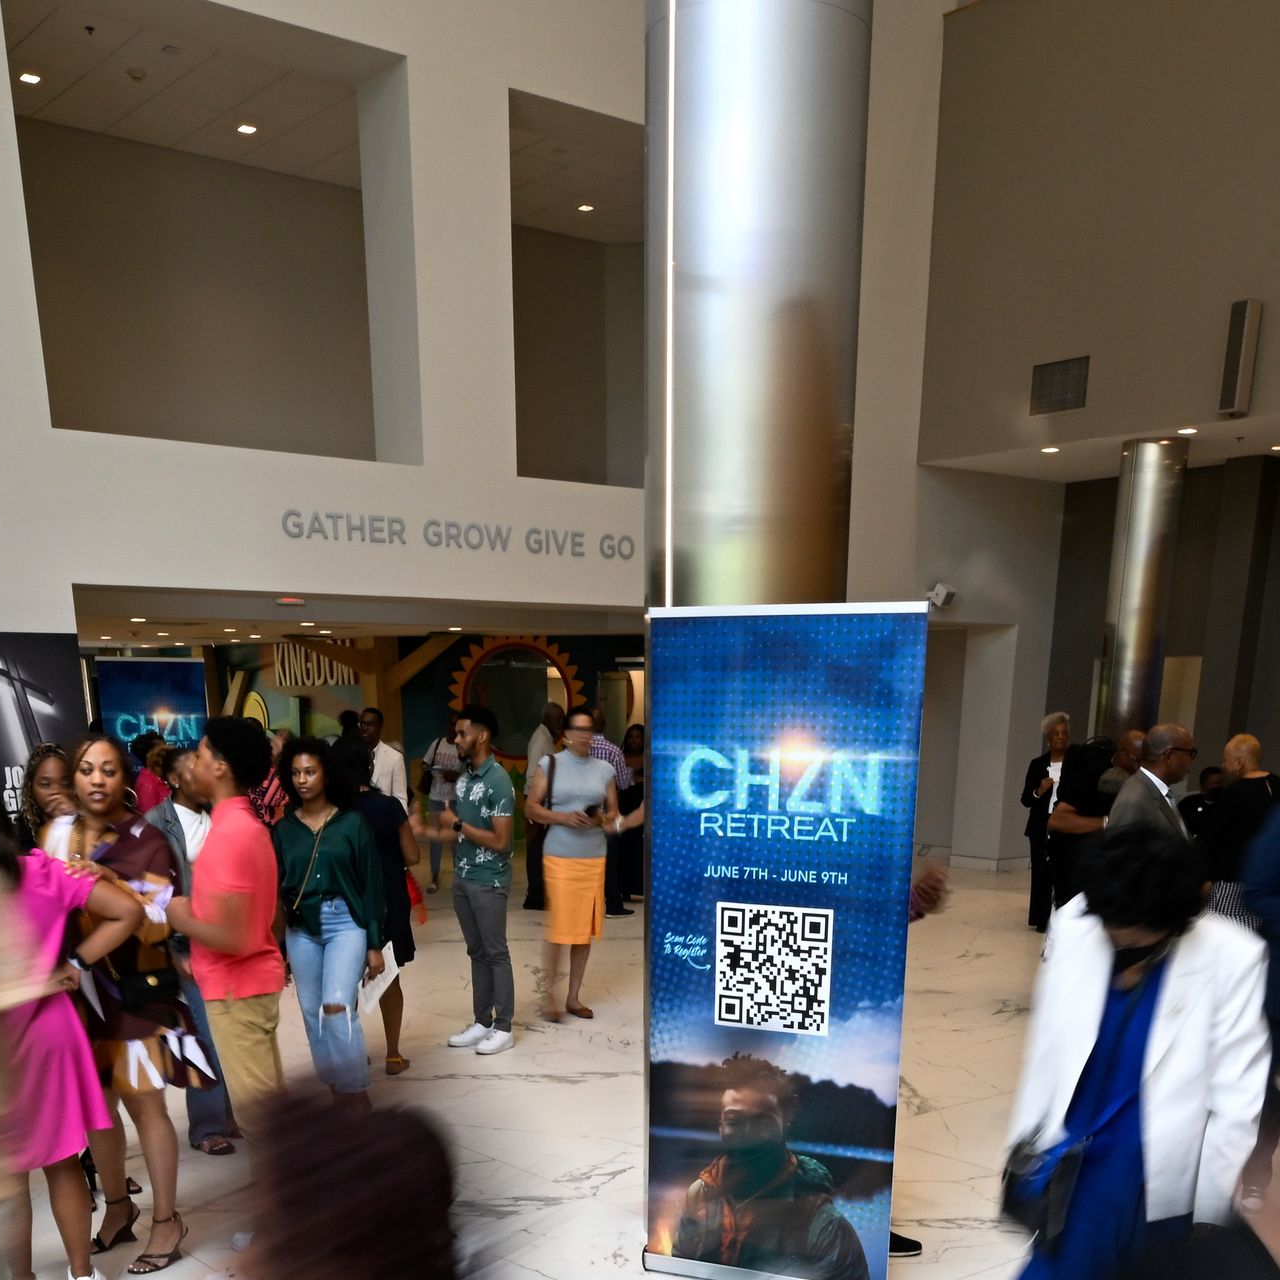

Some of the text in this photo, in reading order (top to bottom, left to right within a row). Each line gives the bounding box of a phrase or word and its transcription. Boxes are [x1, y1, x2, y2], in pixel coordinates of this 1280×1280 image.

[282, 509, 634, 560] GATHER GROW GIVE GO
[116, 713, 198, 741] CHZN
[678, 744, 882, 816] CHZN
[700, 812, 856, 842] RETREAT
[704, 865, 739, 879] JUNE
[743, 867, 768, 881] 7TH
[781, 869, 817, 883] JUNE
[820, 870, 848, 885] 9TH
[664, 932, 707, 945] Scan Code
[674, 945, 707, 960] Register
